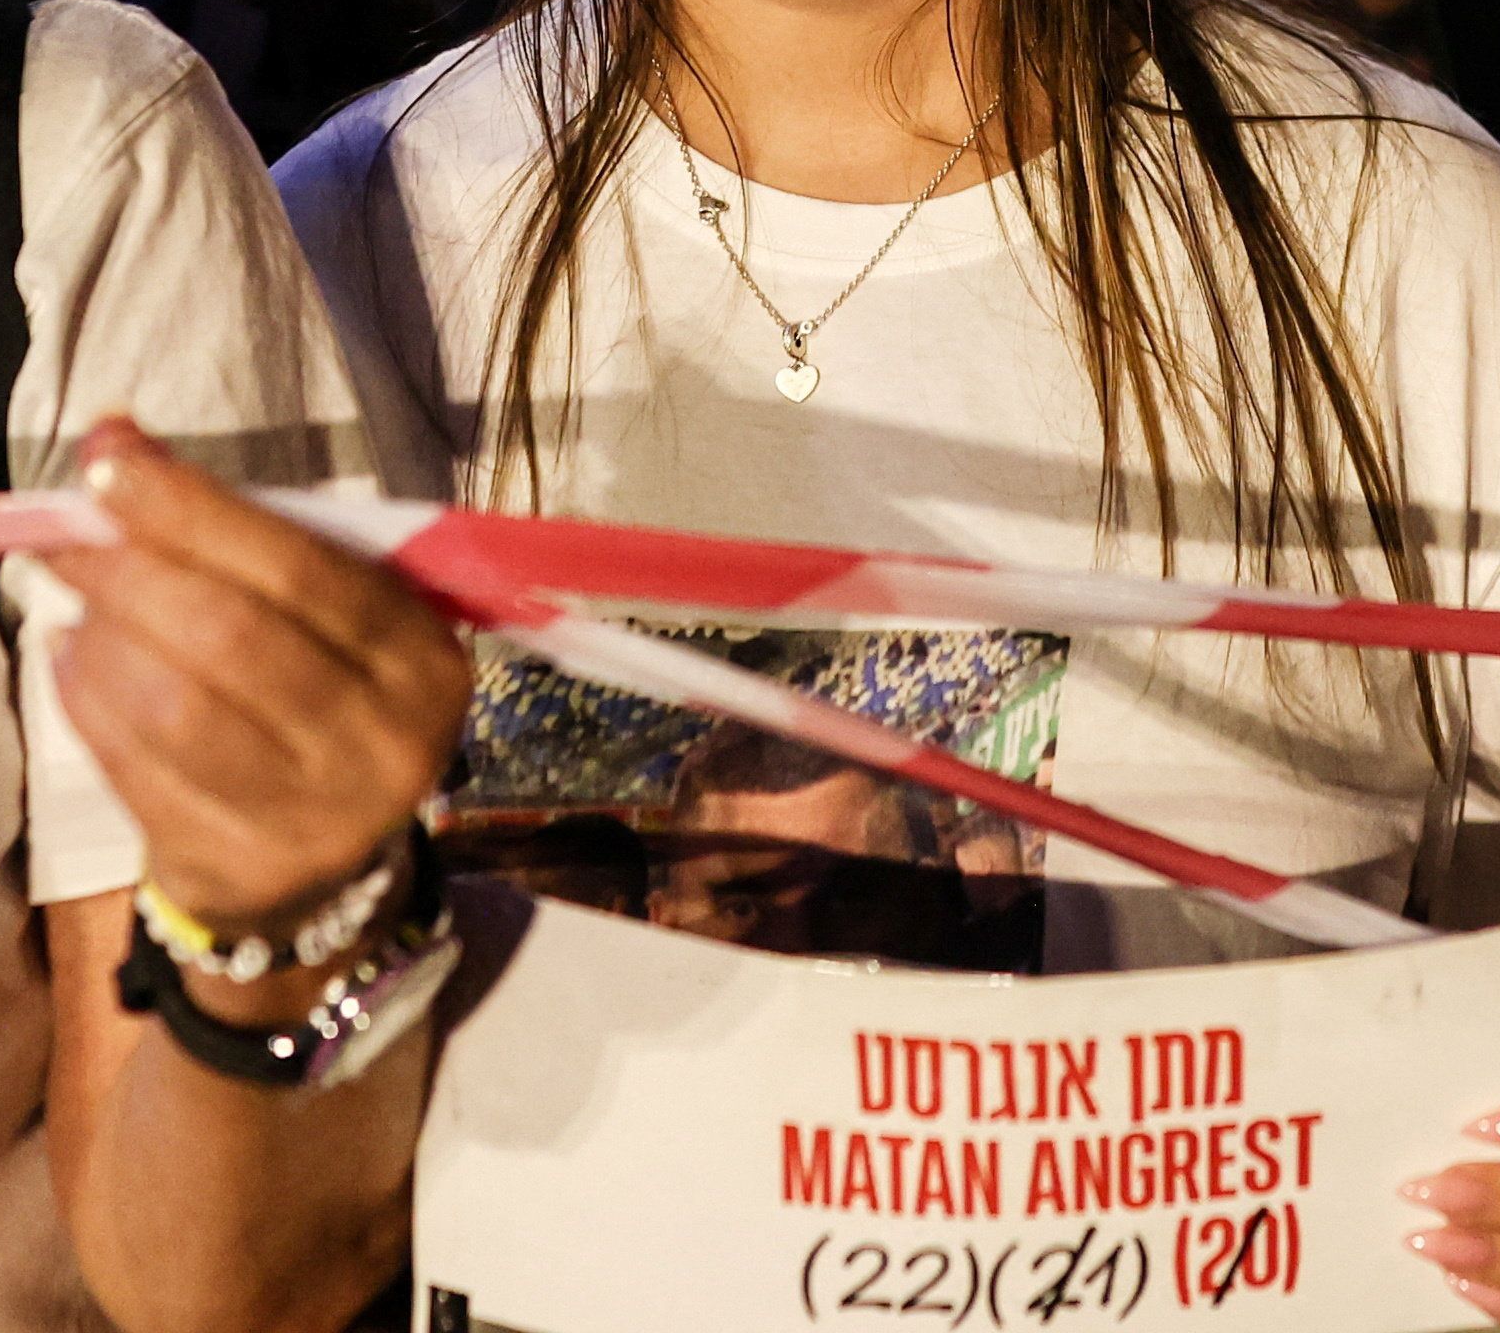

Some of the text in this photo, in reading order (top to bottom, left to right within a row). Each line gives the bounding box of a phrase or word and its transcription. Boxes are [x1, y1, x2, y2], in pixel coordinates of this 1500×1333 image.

[854, 1028, 1245, 1123] מתן אנגרסט
[781, 1114, 1323, 1218] MATAN ANGREST
